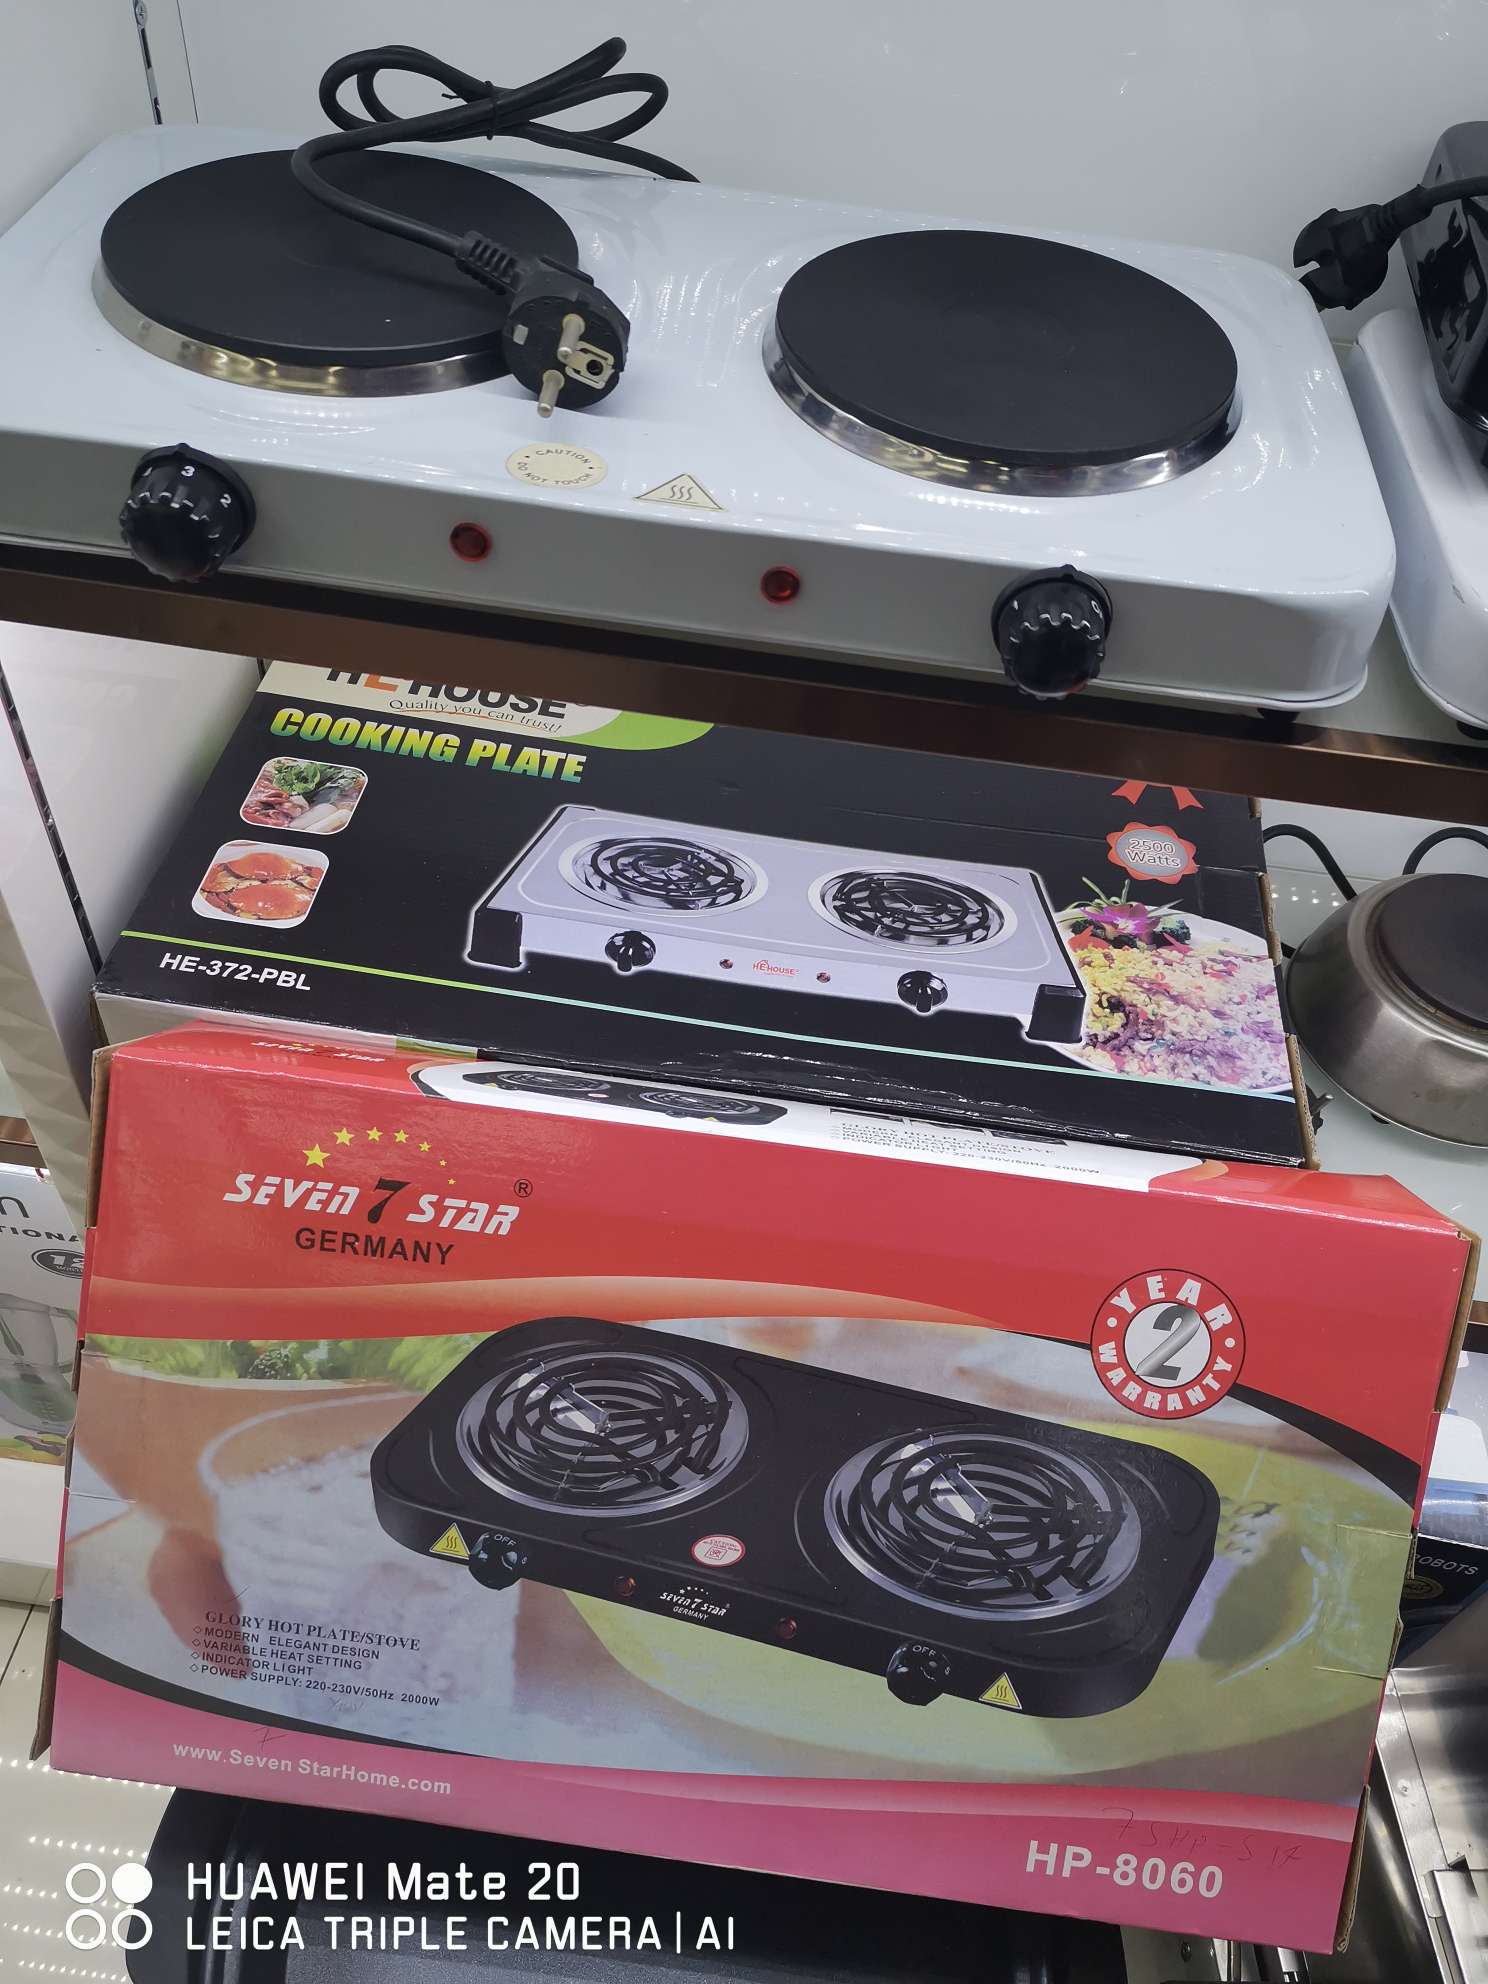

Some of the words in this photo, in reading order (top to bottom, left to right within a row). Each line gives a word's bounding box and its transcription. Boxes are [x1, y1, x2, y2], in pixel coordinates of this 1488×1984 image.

[181, 465, 195, 477] 3
[535, 449, 591, 464] CAUTION
[220, 493, 231, 508] 2
[389, 699, 449, 714] Quality
[454, 704, 482, 716] you
[487, 709, 514, 721] can
[520, 715, 562, 733] trust!
[269, 708, 461, 763] COOKING
[465, 738, 587, 783] PLATE
[1125, 849, 1181, 867] Watts
[1128, 838, 1176, 855] 2500
[159, 952, 312, 991] HE-372-PBL
[222, 1173, 360, 1215] SEVEN
[367, 1176, 411, 1224] 7
[406, 1193, 520, 1236] STAR
[295, 1227, 455, 1265] GERMANY
[1110, 1274, 1233, 1332] YEAR
[1135, 1304, 1201, 1381] 2
[1098, 1341, 1233, 1412] WARRANTY
[494, 1533, 517, 1546] OFF
[660, 1592, 691, 1606] SEVEN
[691, 1598, 703, 1609] 7
[700, 1603, 727, 1616] STAR
[673, 1606, 709, 1621] GERMANY
[204, 1627, 259, 1643] MODERN
[269, 1636, 329, 1652] ELEGANT
[332, 1644, 380, 1660] DESIGN
[206, 1611, 264, 1629] GLORY
[268, 1619, 303, 1635] HOT
[307, 1624, 421, 1652] PLATE/STOVE
[202, 1652, 270, 1670] INDICATOR
[273, 1662, 314, 1676] LIGHT
[203, 1639, 268, 1657] VARIABLE
[271, 1649, 304, 1662] HEAT
[307, 1654, 362, 1670] SETTING
[912, 1644, 937, 1657] OFF
[201, 1664, 247, 1679] POWER
[250, 1671, 302, 1688] SUPPLY:
[306, 1679, 395, 1701] 220-230V/50Hz
[400, 1692, 440, 1706] 2000W
[298, 1759, 451, 1795] StarHome.com
[1025, 1839, 1223, 1898] HP-8060
